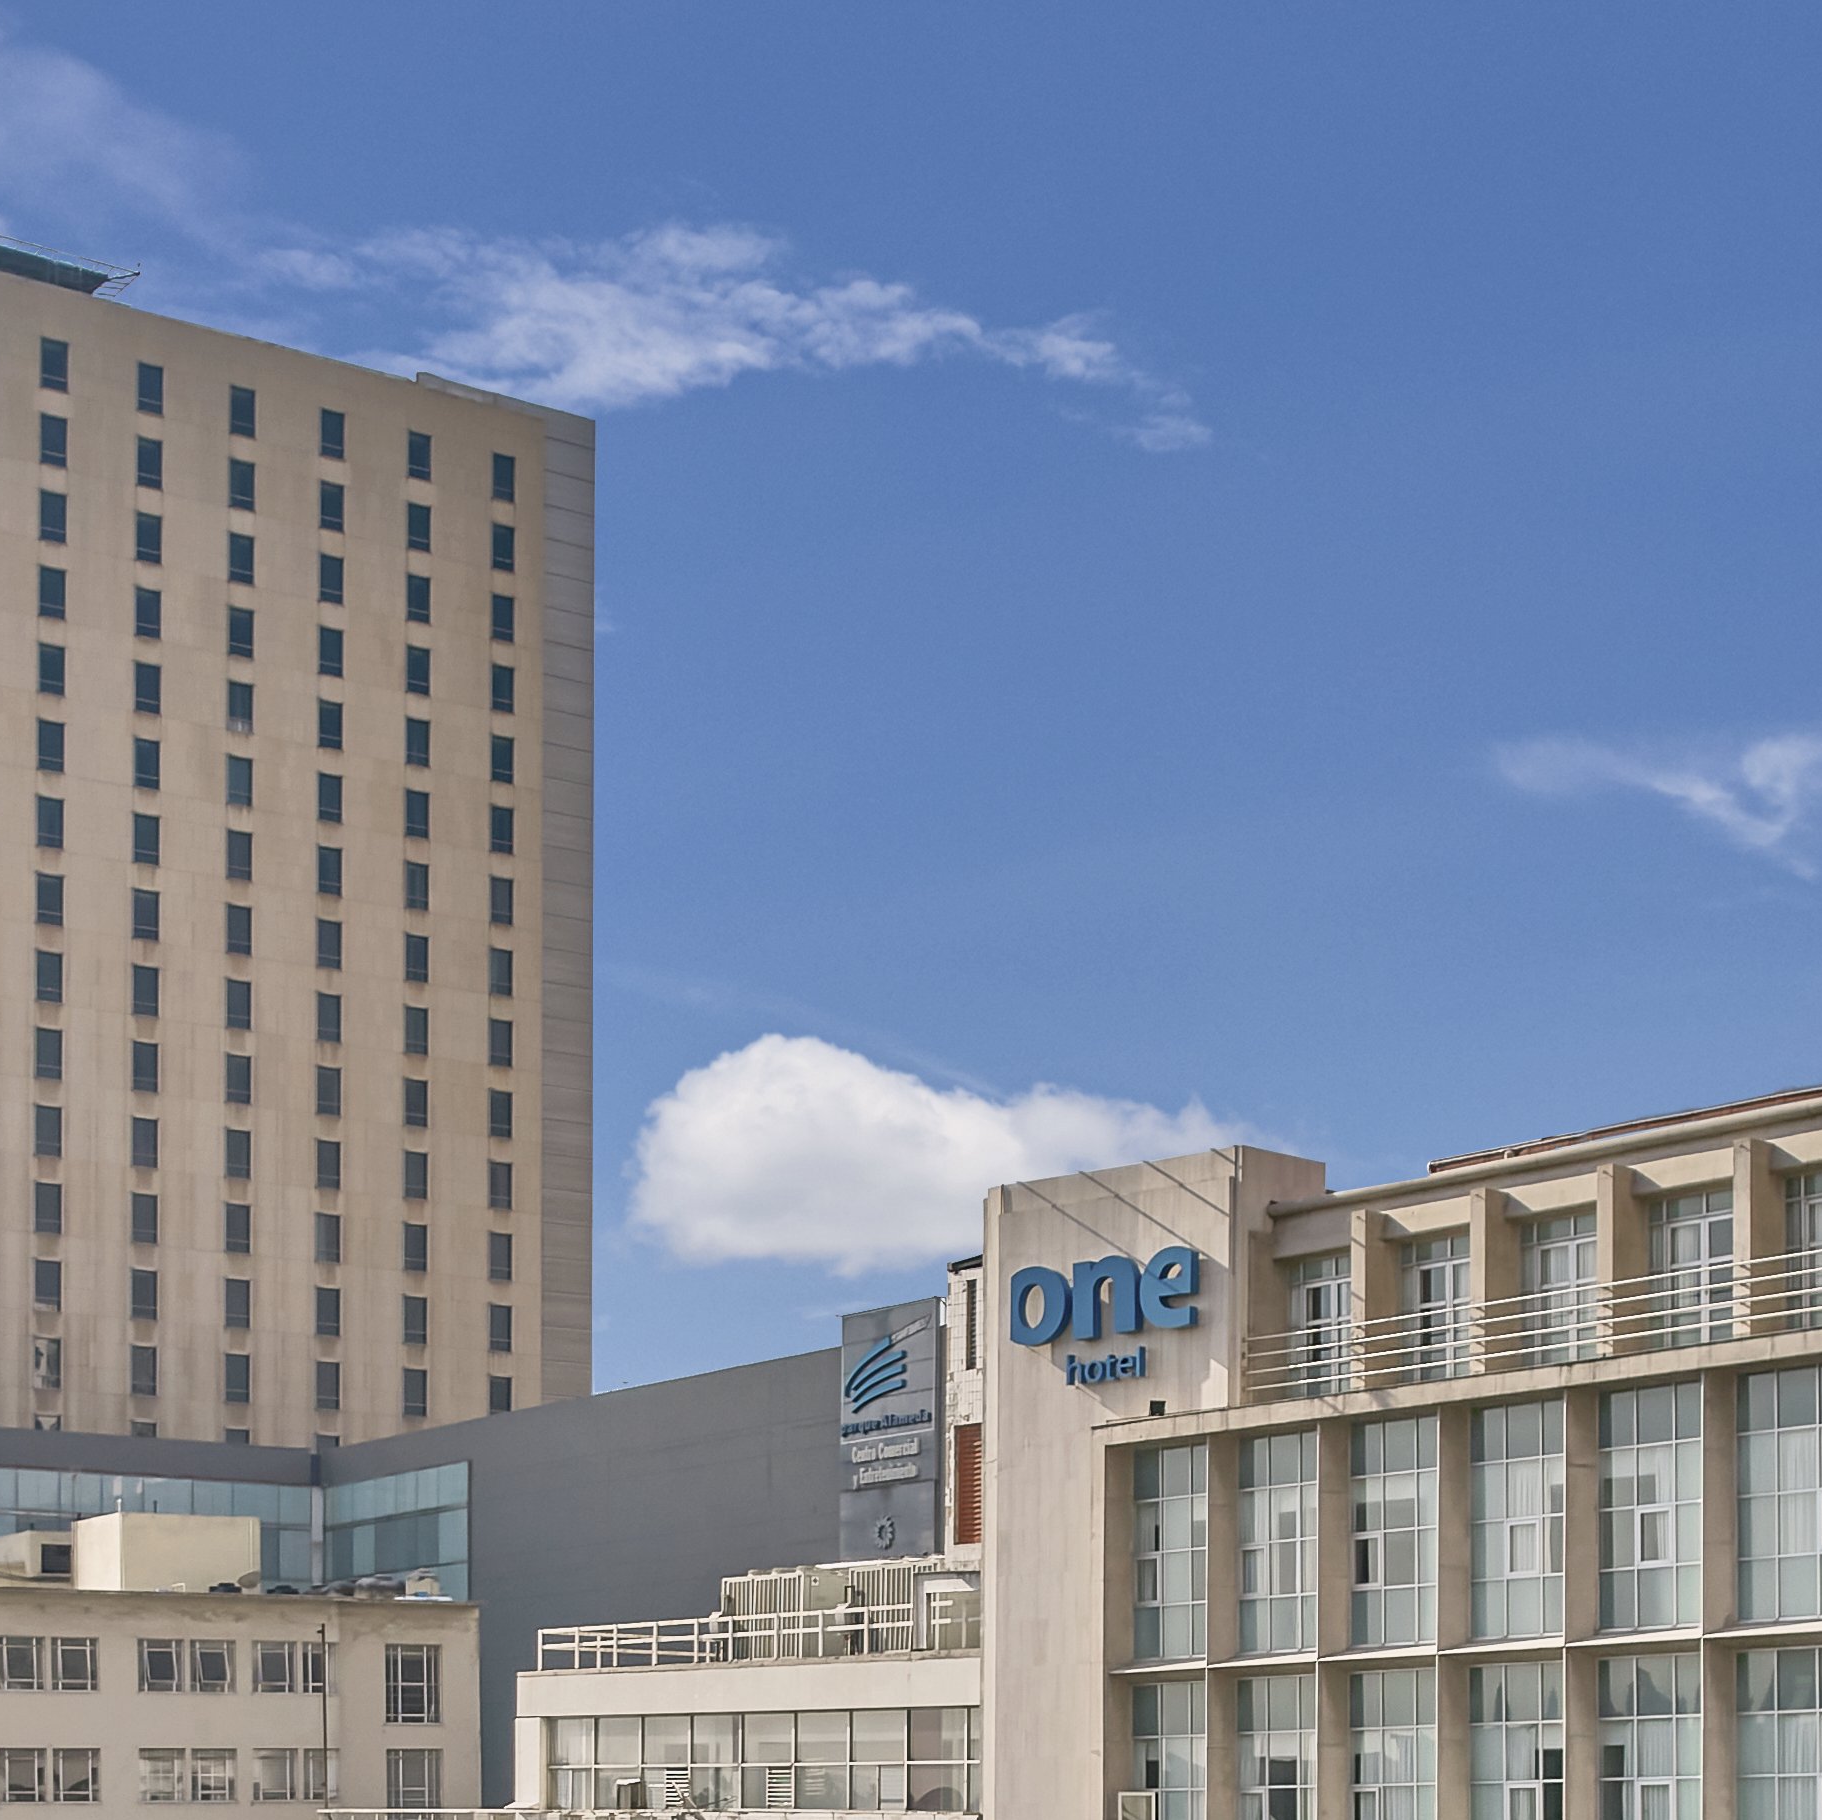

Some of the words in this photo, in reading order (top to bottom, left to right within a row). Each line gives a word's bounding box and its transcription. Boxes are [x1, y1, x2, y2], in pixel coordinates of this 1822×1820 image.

[1010, 1245, 1201, 1347] one
[1065, 1345, 1147, 1386] hotel
[880, 1409, 933, 1431] Alameda
[851, 1444, 877, 1464] Centro
[878, 1437, 921, 1460] Comercial
[852, 1474, 859, 1490] y
